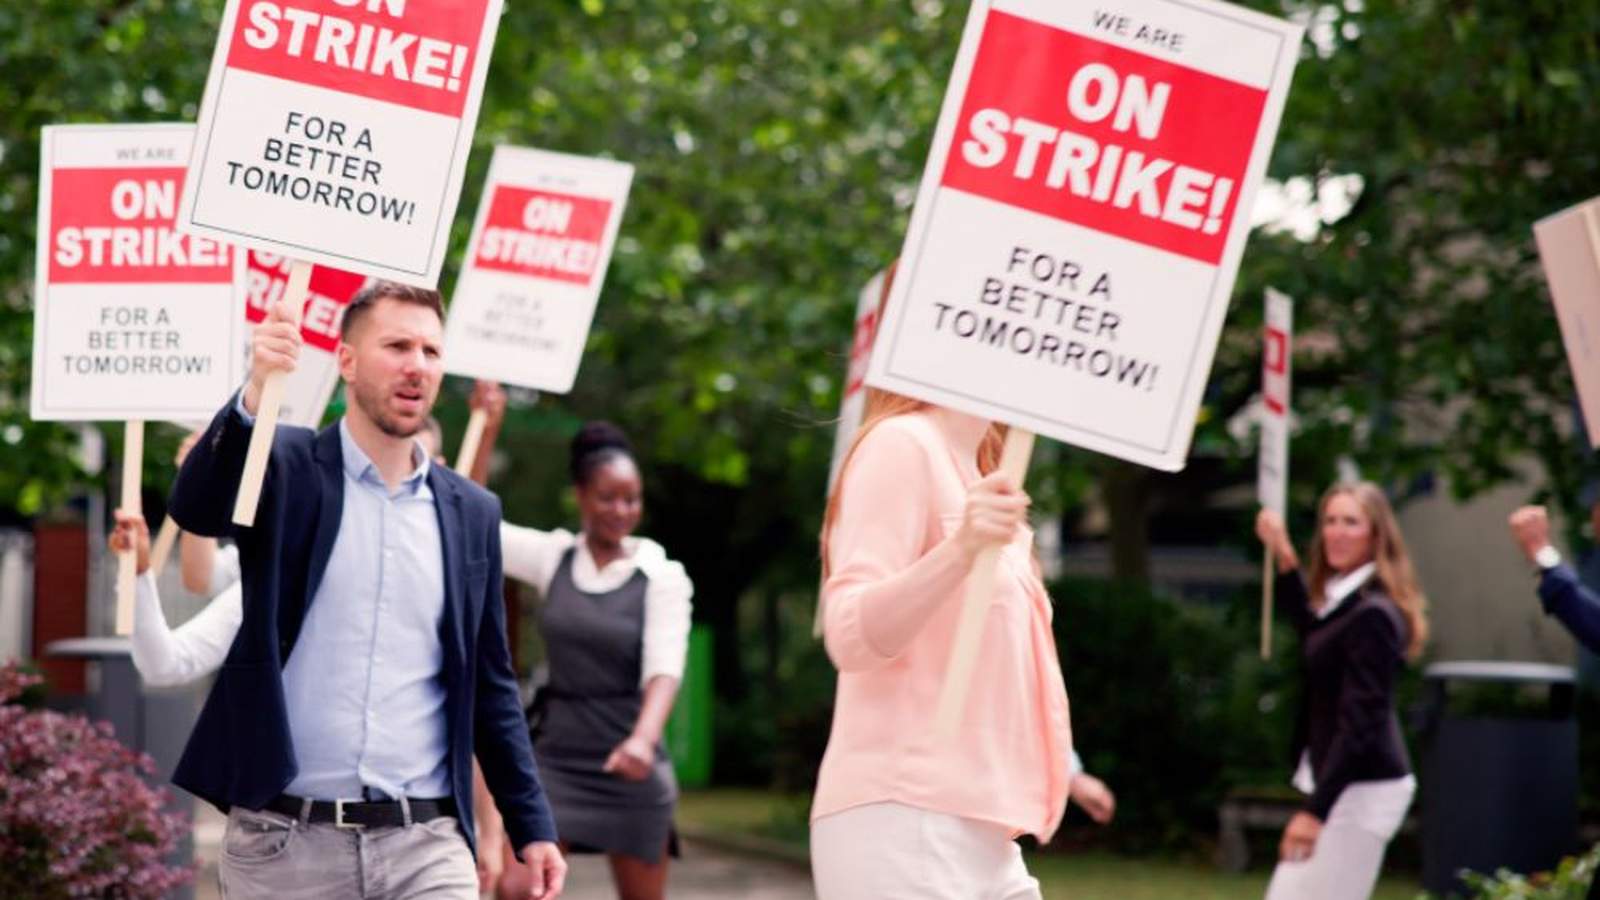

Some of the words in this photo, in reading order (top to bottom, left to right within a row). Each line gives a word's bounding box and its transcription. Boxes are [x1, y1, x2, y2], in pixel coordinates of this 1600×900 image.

[244, 2, 469, 92] STRIKE!
[1093, 11, 1129, 34] WE
[1135, 27, 1185, 53] ARE
[1067, 63, 1172, 140] ON
[285, 112, 347, 146] FOR
[354, 129, 373, 152] A
[116, 148, 141, 160] WE
[146, 148, 176, 160] ARE
[264, 138, 382, 185] BETTER
[962, 109, 1233, 235] STRIKE!
[111, 180, 175, 220] ON
[227, 161, 415, 225] TOMORROW!
[522, 197, 575, 233] ON
[54, 227, 229, 268] STRIKE!
[1007, 247, 1079, 291] FOR
[1089, 273, 1112, 300] A
[100, 308, 148, 325] FOR
[156, 307, 171, 324] A
[980, 277, 1120, 341] BETTER
[89, 331, 179, 349] BETTER
[933, 303, 1158, 392] TOMORROW!
[63, 355, 213, 375] TOMORROW!
